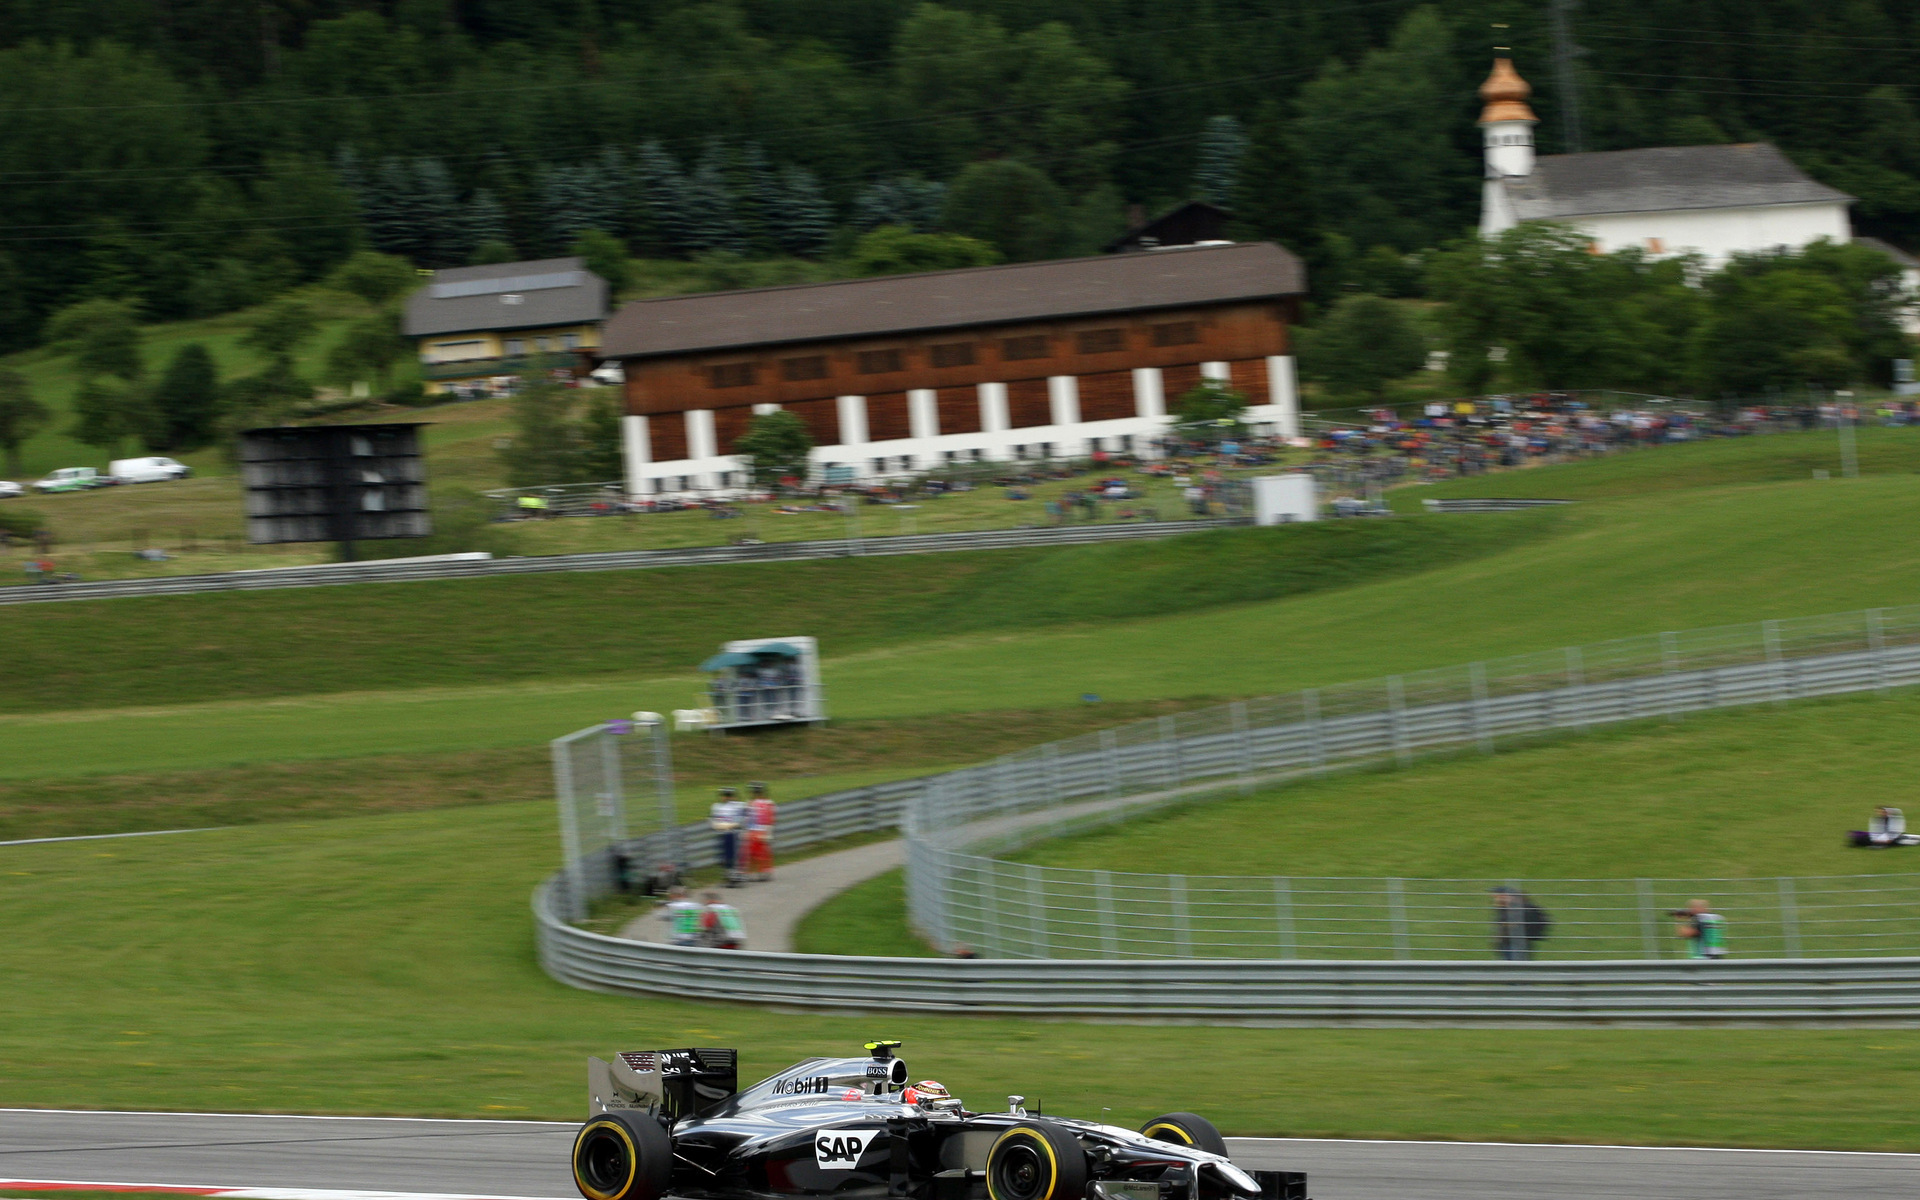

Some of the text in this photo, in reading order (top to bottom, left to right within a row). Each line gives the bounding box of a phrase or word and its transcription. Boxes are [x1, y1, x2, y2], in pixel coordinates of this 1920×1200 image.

[867, 1067, 887, 1075] BOSS
[772, 1077, 812, 1094] Mobil
[817, 1136, 862, 1162] SAP
